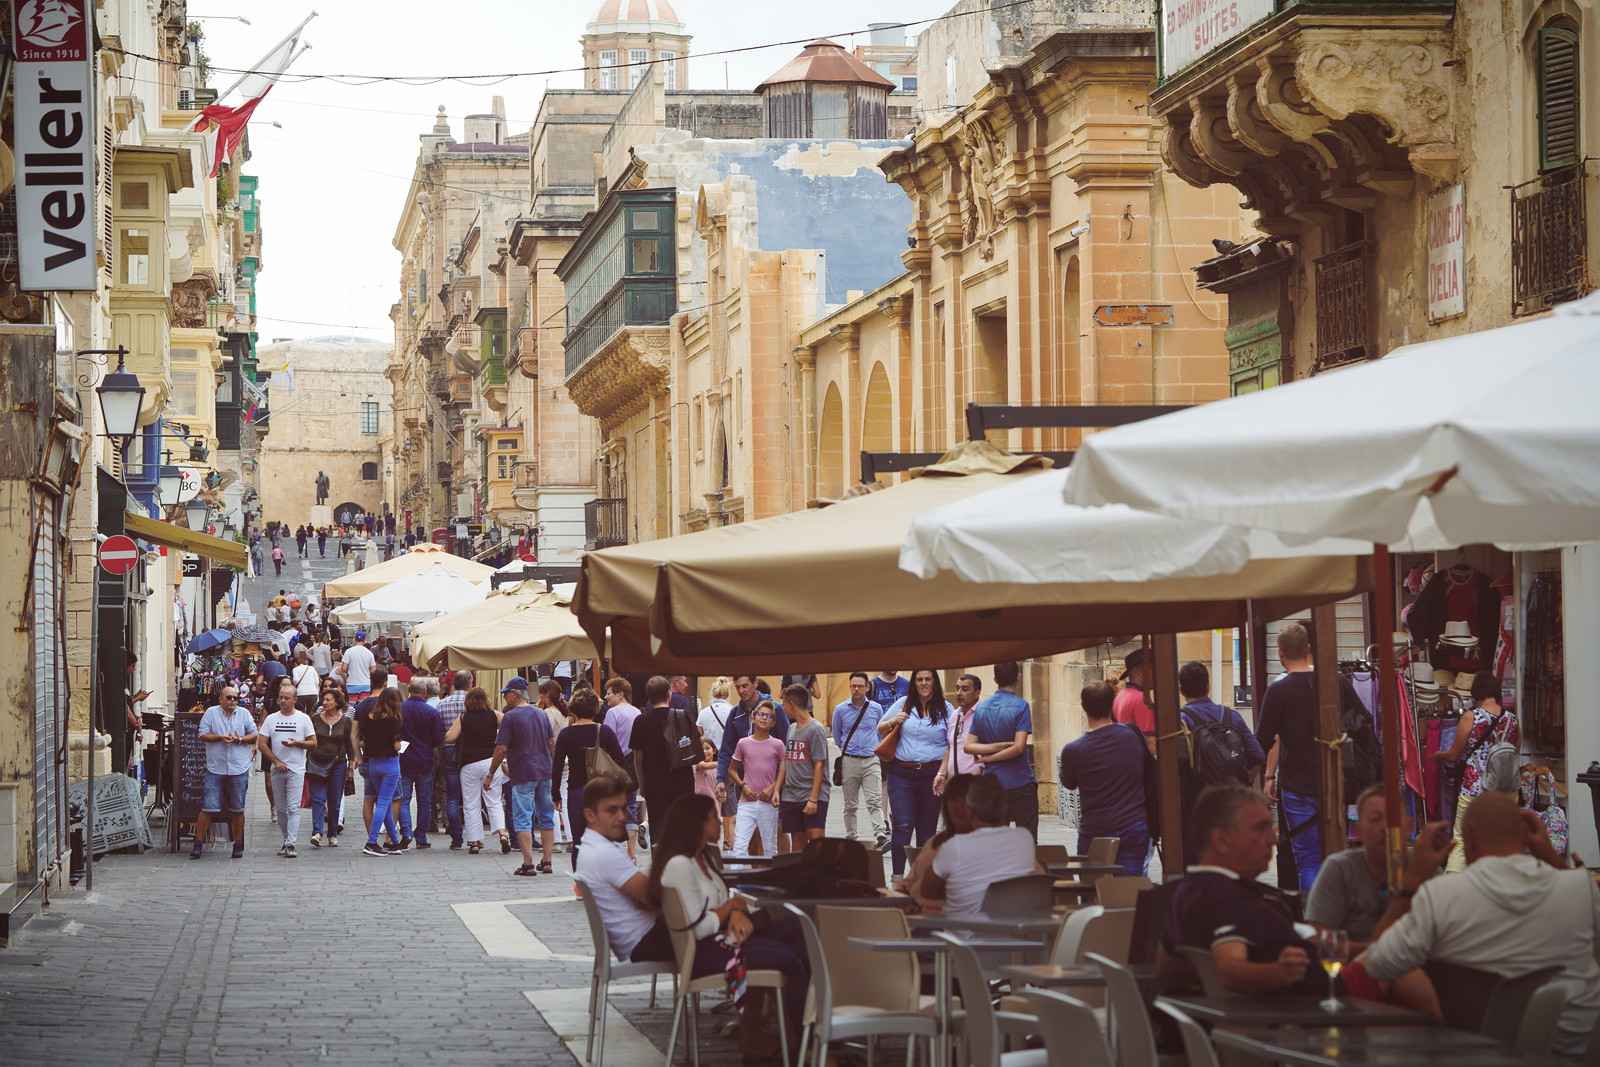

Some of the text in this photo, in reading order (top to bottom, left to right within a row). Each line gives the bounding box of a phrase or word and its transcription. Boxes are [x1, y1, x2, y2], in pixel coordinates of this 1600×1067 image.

[23, 49, 80, 59] Since 1918
[24, 77, 87, 272] veller
[1430, 258, 1460, 304] DELIA
[181, 480, 198, 491] BC
[182, 563, 197, 573] OP
